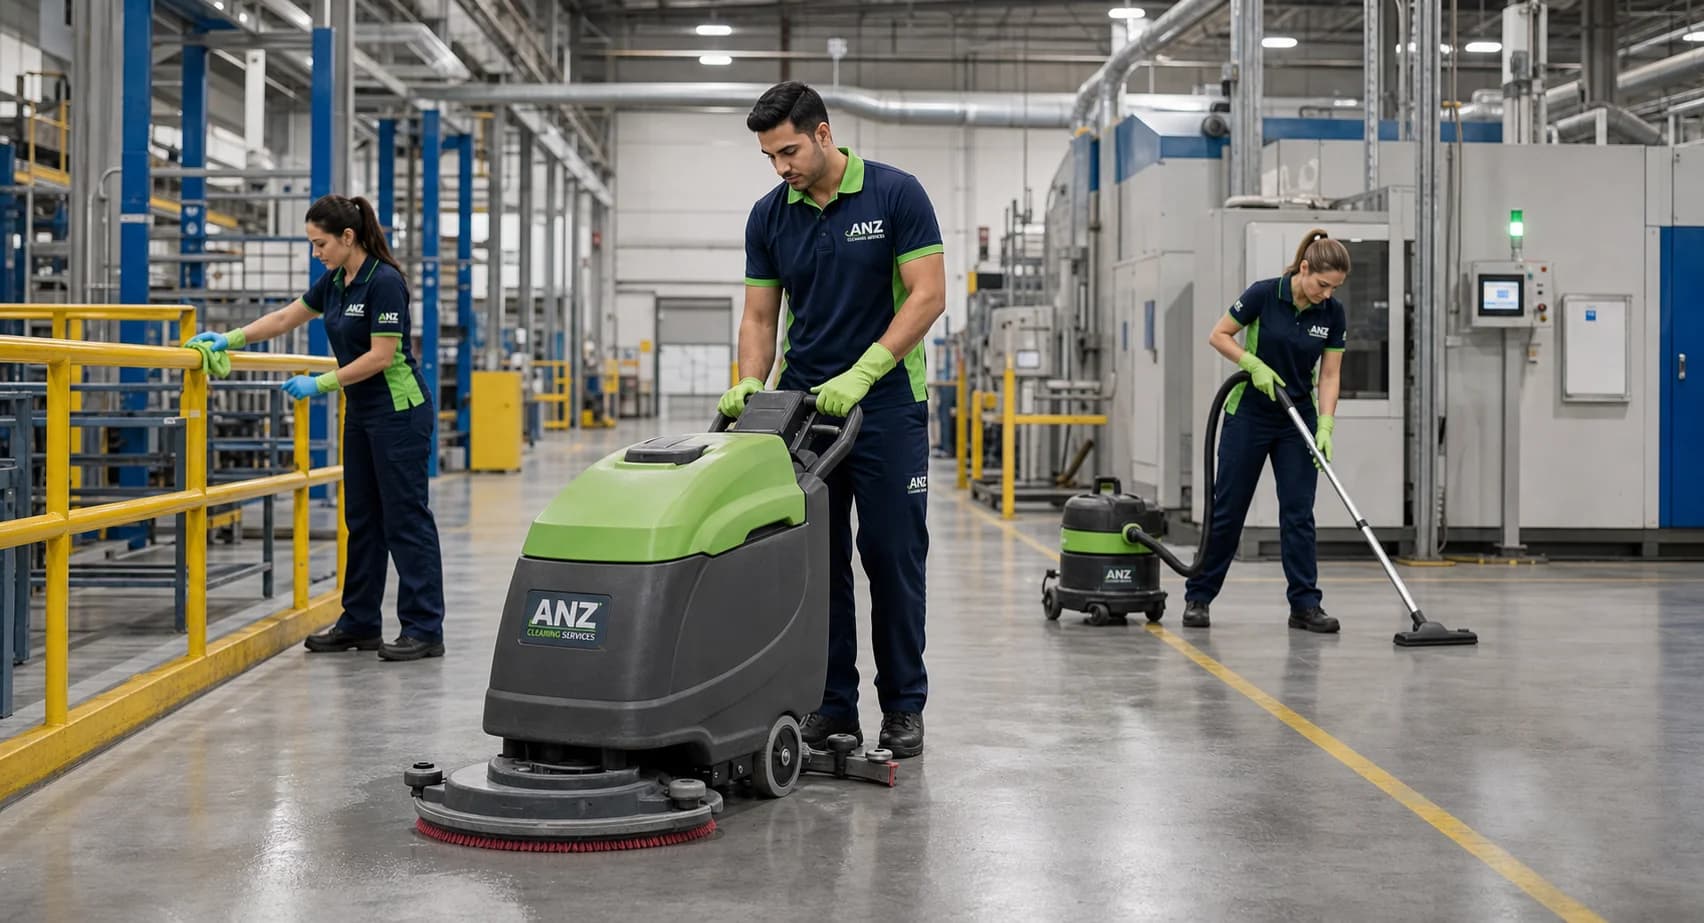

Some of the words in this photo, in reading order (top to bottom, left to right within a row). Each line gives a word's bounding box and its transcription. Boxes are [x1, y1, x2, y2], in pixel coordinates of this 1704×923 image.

[849, 219, 884, 237] ANZ
[345, 303, 365, 313] ANZ
[378, 312, 399, 321] ANZ
[1310, 324, 1330, 337] ANZ
[909, 476, 927, 489] ANZ
[1107, 569, 1132, 579] ANZ
[531, 598, 599, 629] ANZ
[527, 628, 561, 638] CLEANG
[561, 631, 596, 641] SERVICES
